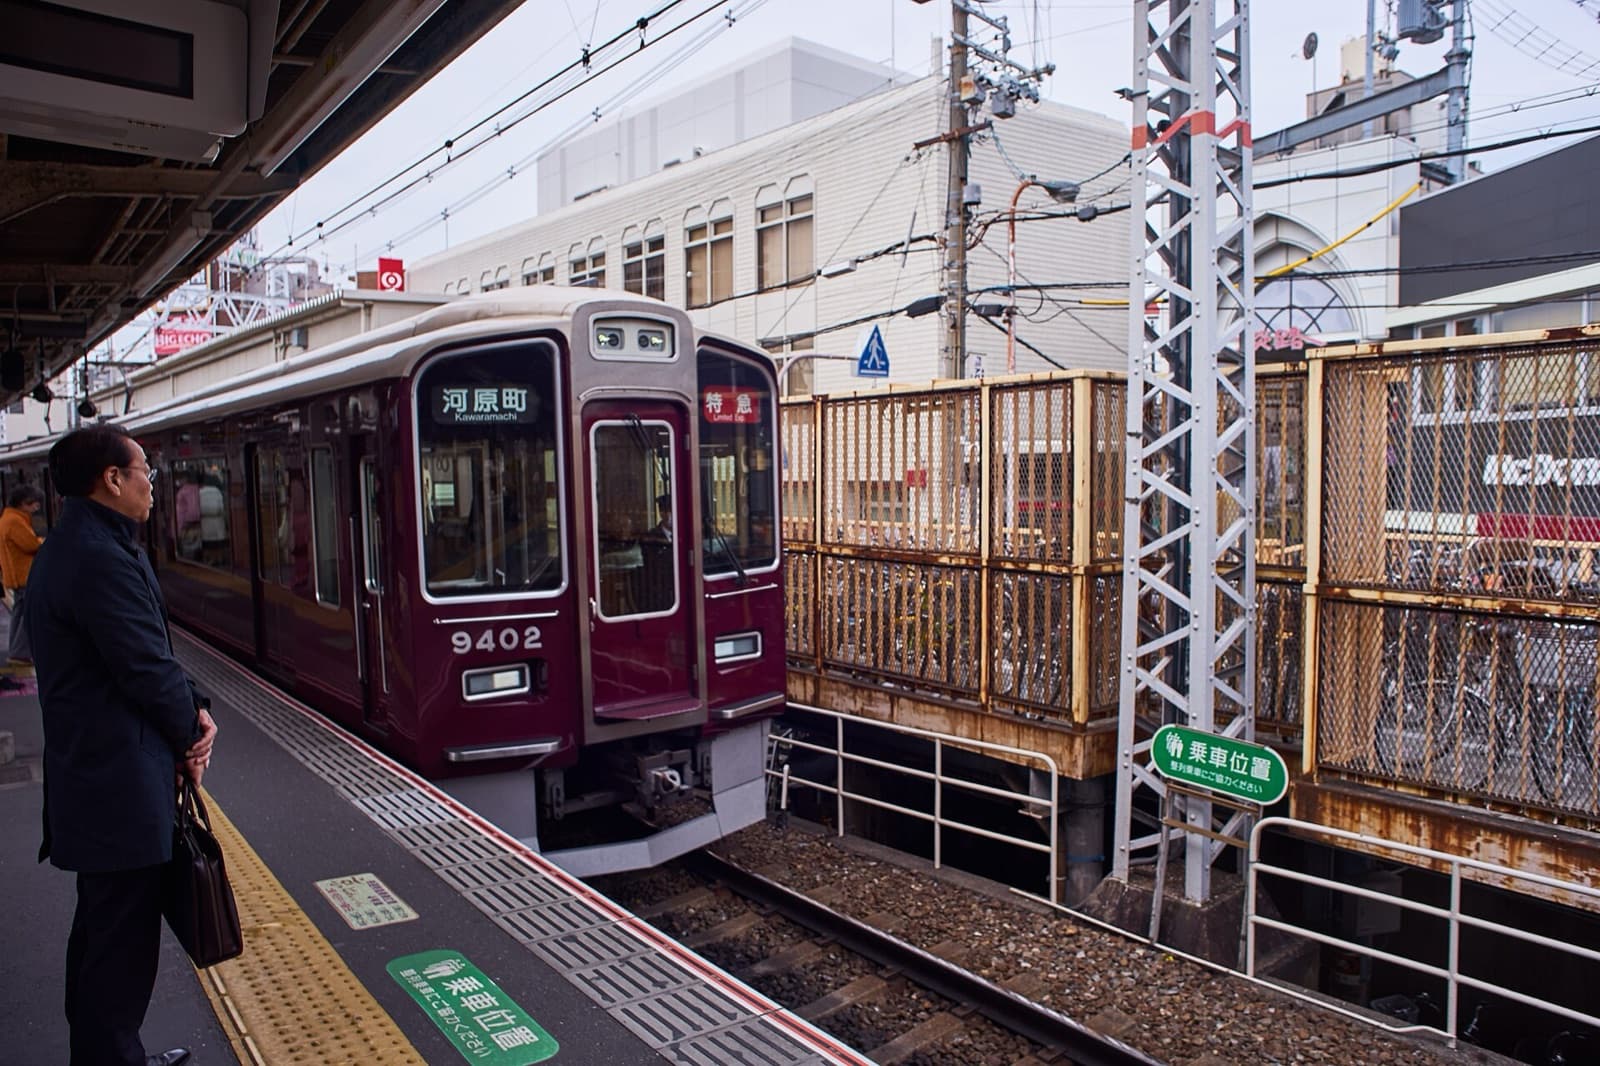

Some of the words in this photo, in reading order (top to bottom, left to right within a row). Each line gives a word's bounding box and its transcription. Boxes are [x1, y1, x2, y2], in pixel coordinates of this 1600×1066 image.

[442, 388, 527, 413] 河原町
[706, 391, 752, 414] 特急
[454, 412, 517, 422] Kawaramachi
[451, 626, 543, 655] 9402
[1188, 740, 1271, 781] 乗車位置
[1170, 760, 1263, 794] 整列乗車にご協力ください
[441, 976, 540, 1051] 乗車位置
